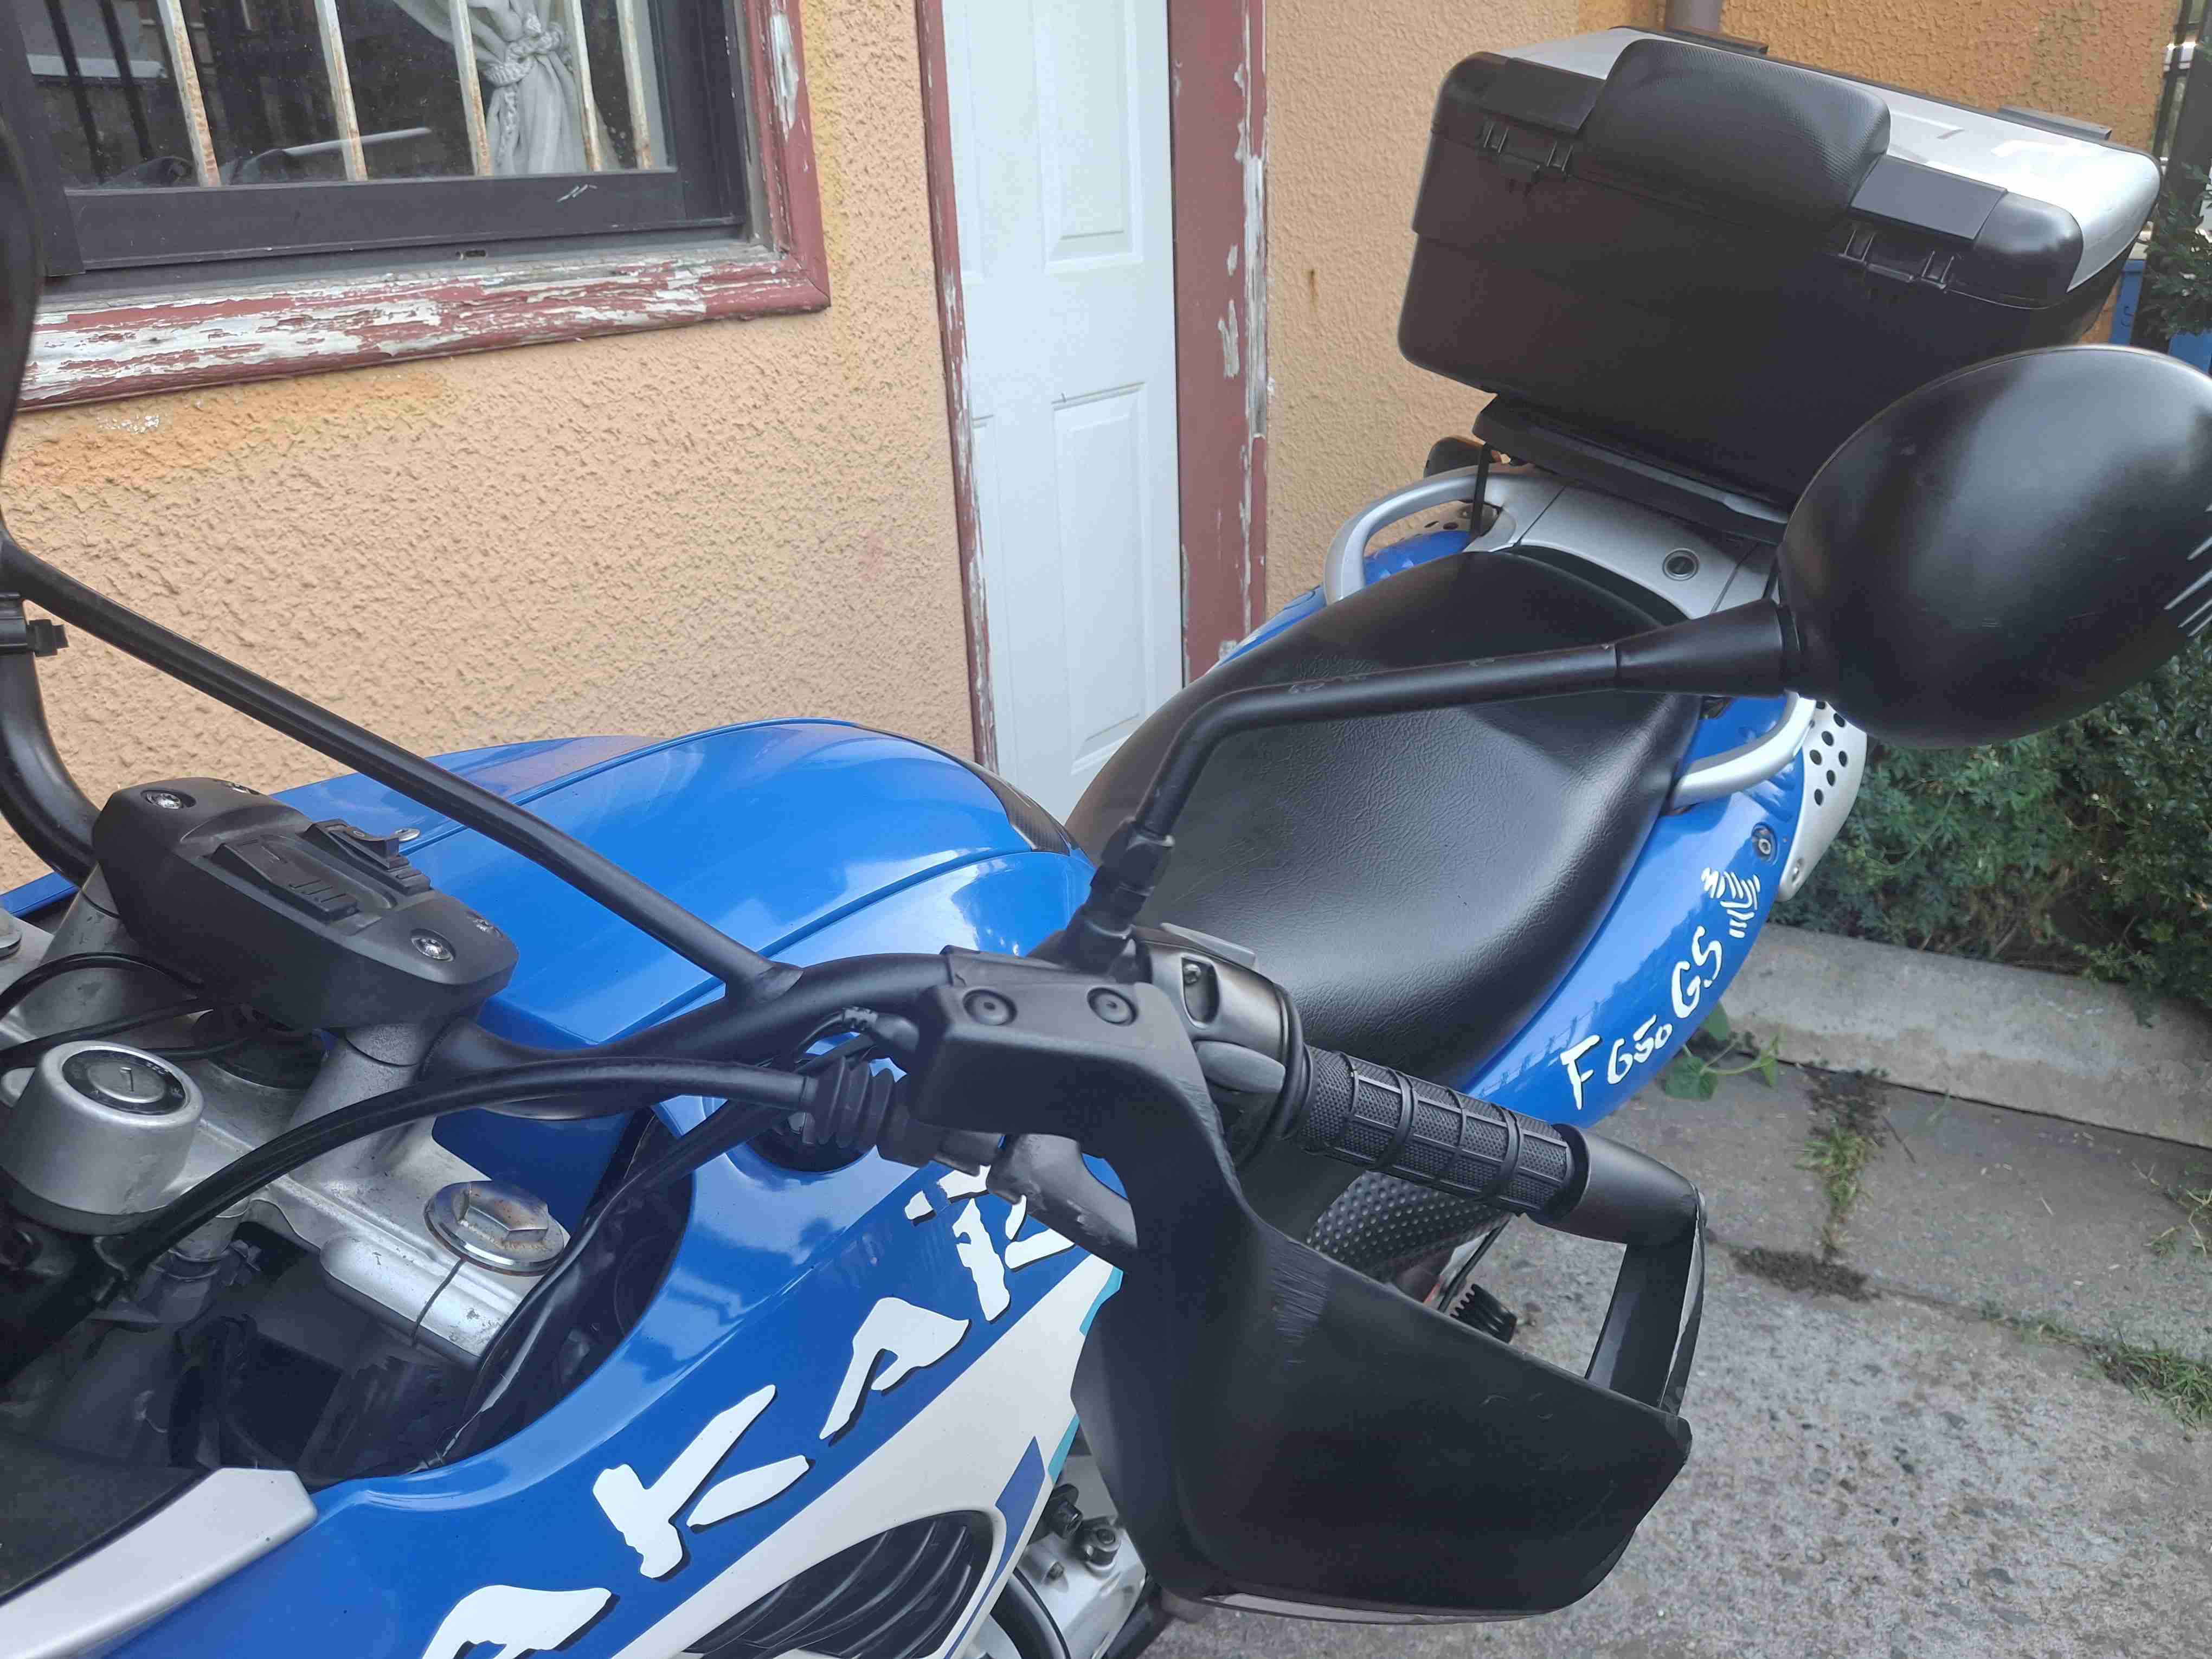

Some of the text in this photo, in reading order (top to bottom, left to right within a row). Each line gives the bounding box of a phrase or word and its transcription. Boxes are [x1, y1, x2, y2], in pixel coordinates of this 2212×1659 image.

[1560, 925, 1722, 1110] F 650 GS
